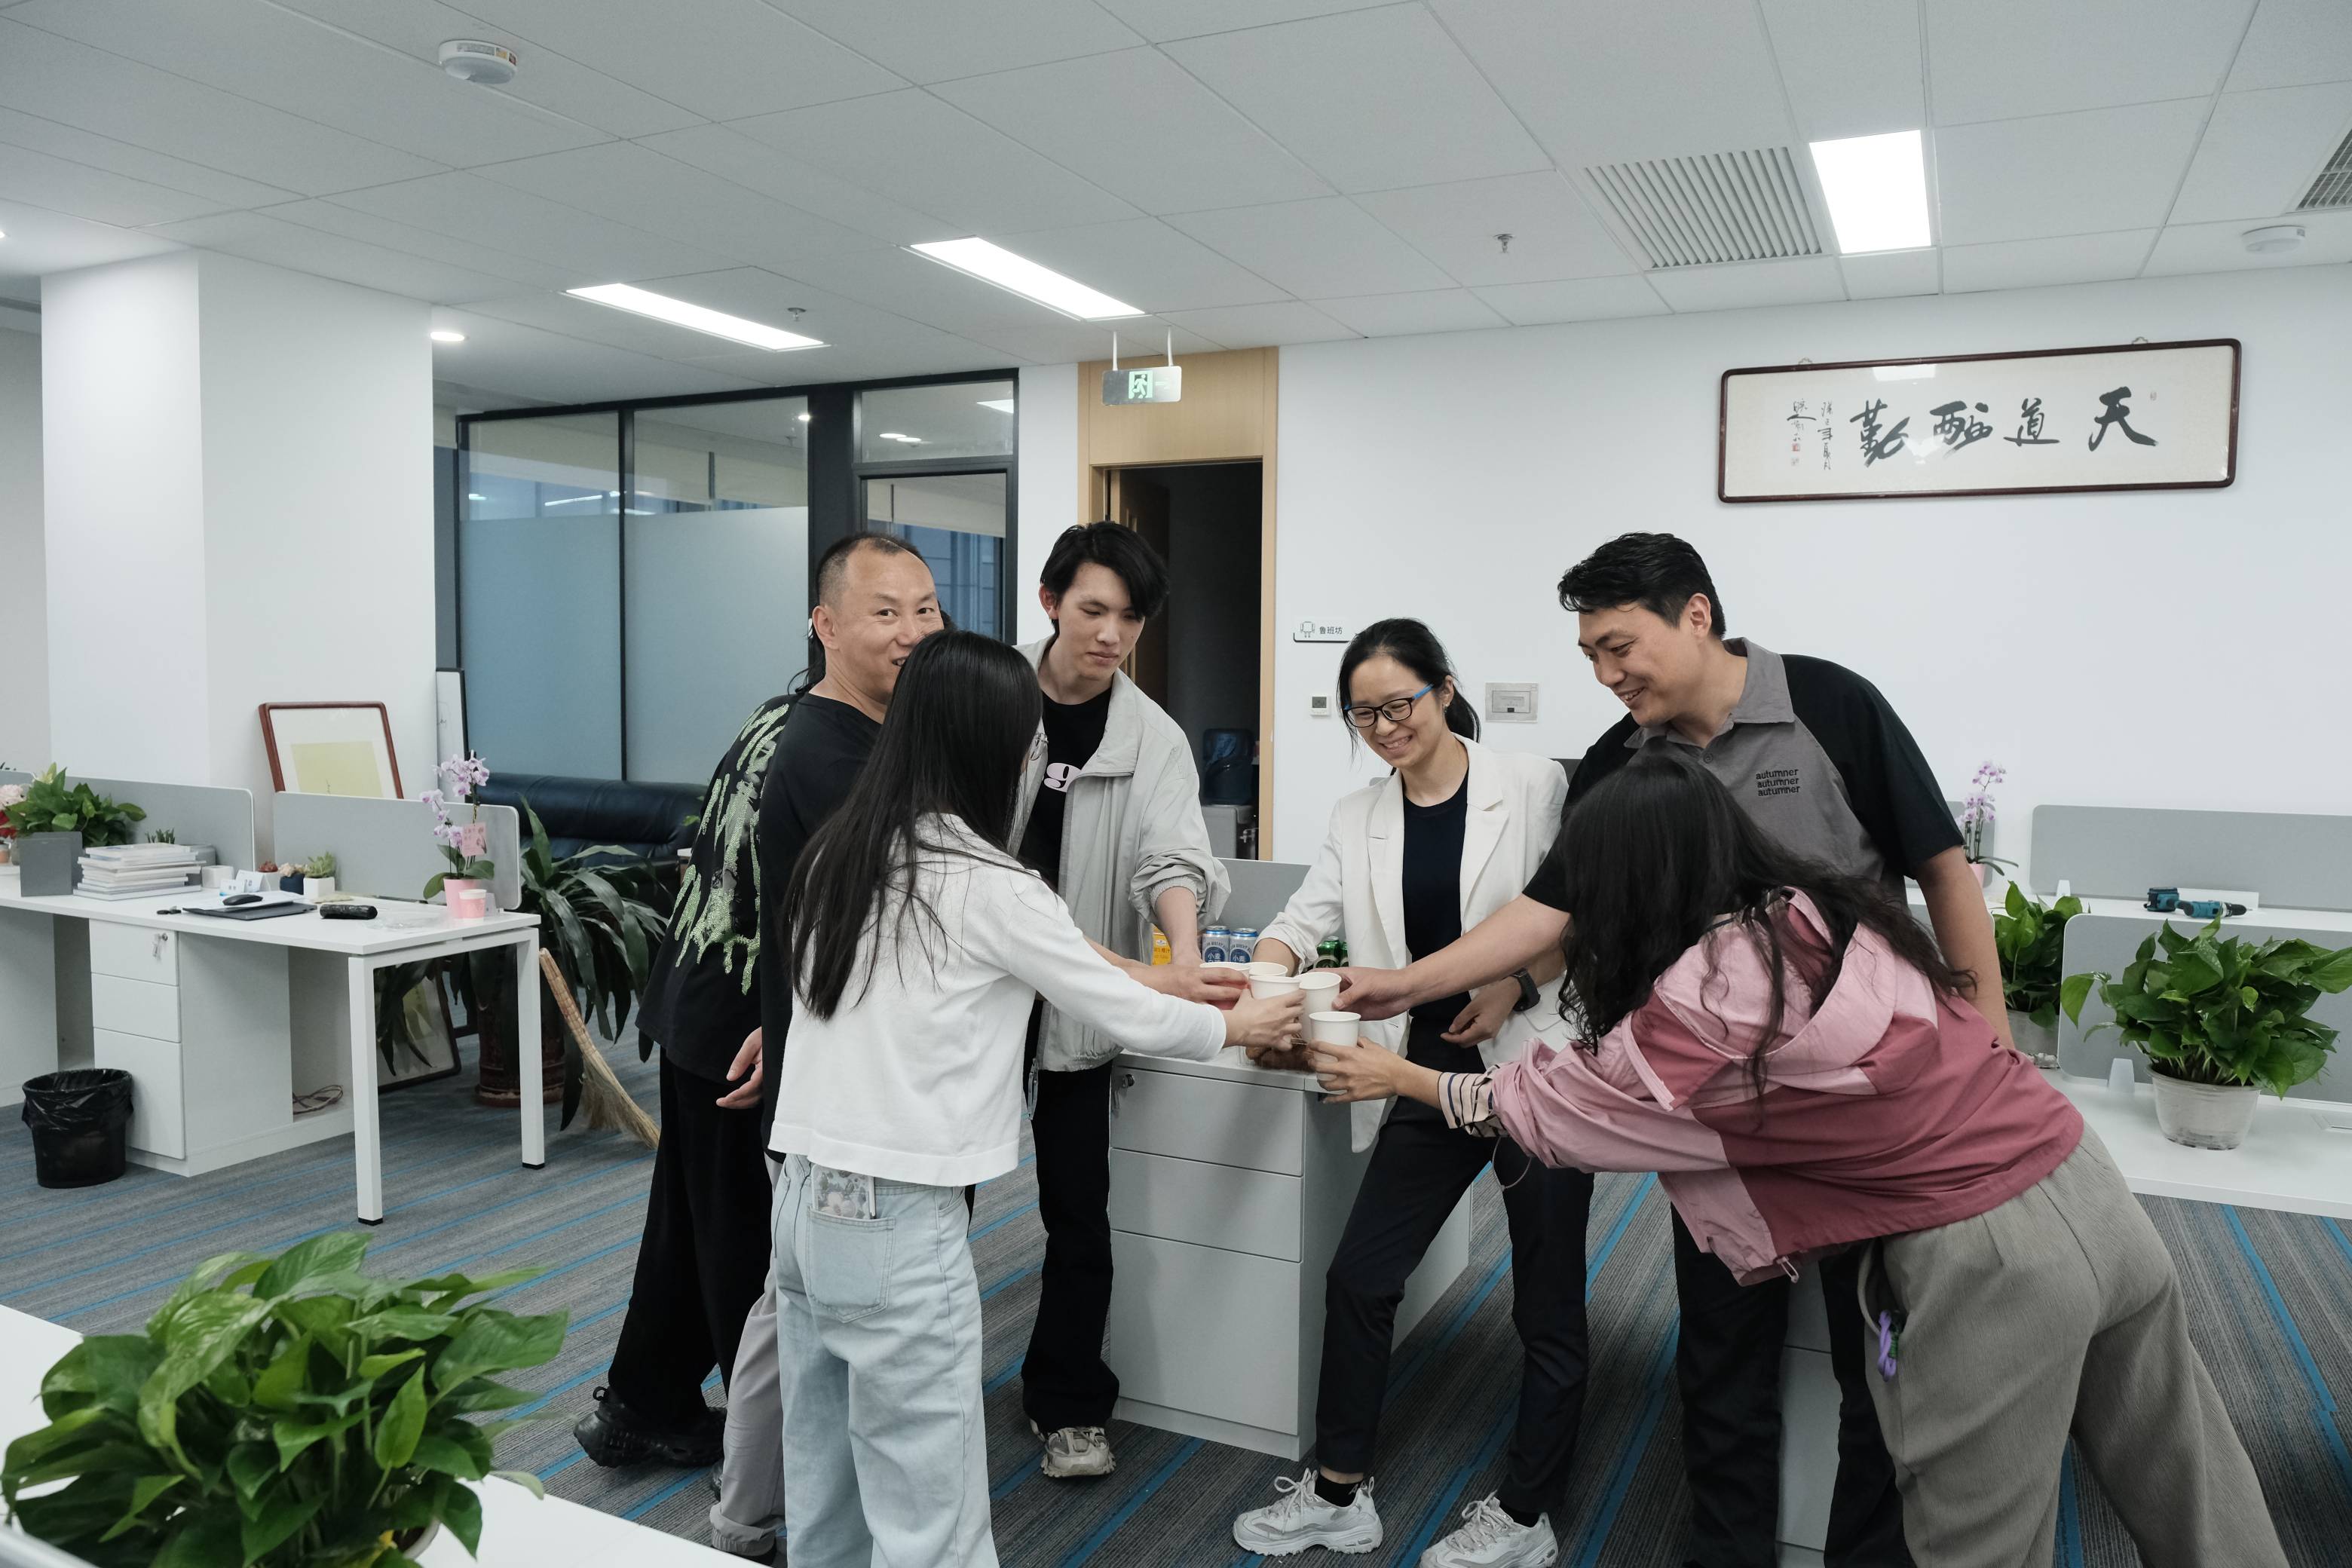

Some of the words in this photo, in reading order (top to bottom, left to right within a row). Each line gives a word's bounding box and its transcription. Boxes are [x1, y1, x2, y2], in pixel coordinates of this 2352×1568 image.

[1319, 626, 1343, 635] 鲁班坊
[1756, 769, 1799, 779] autumner
[1757, 778, 1799, 789] autumner
[1758, 786, 1800, 796] autumner
